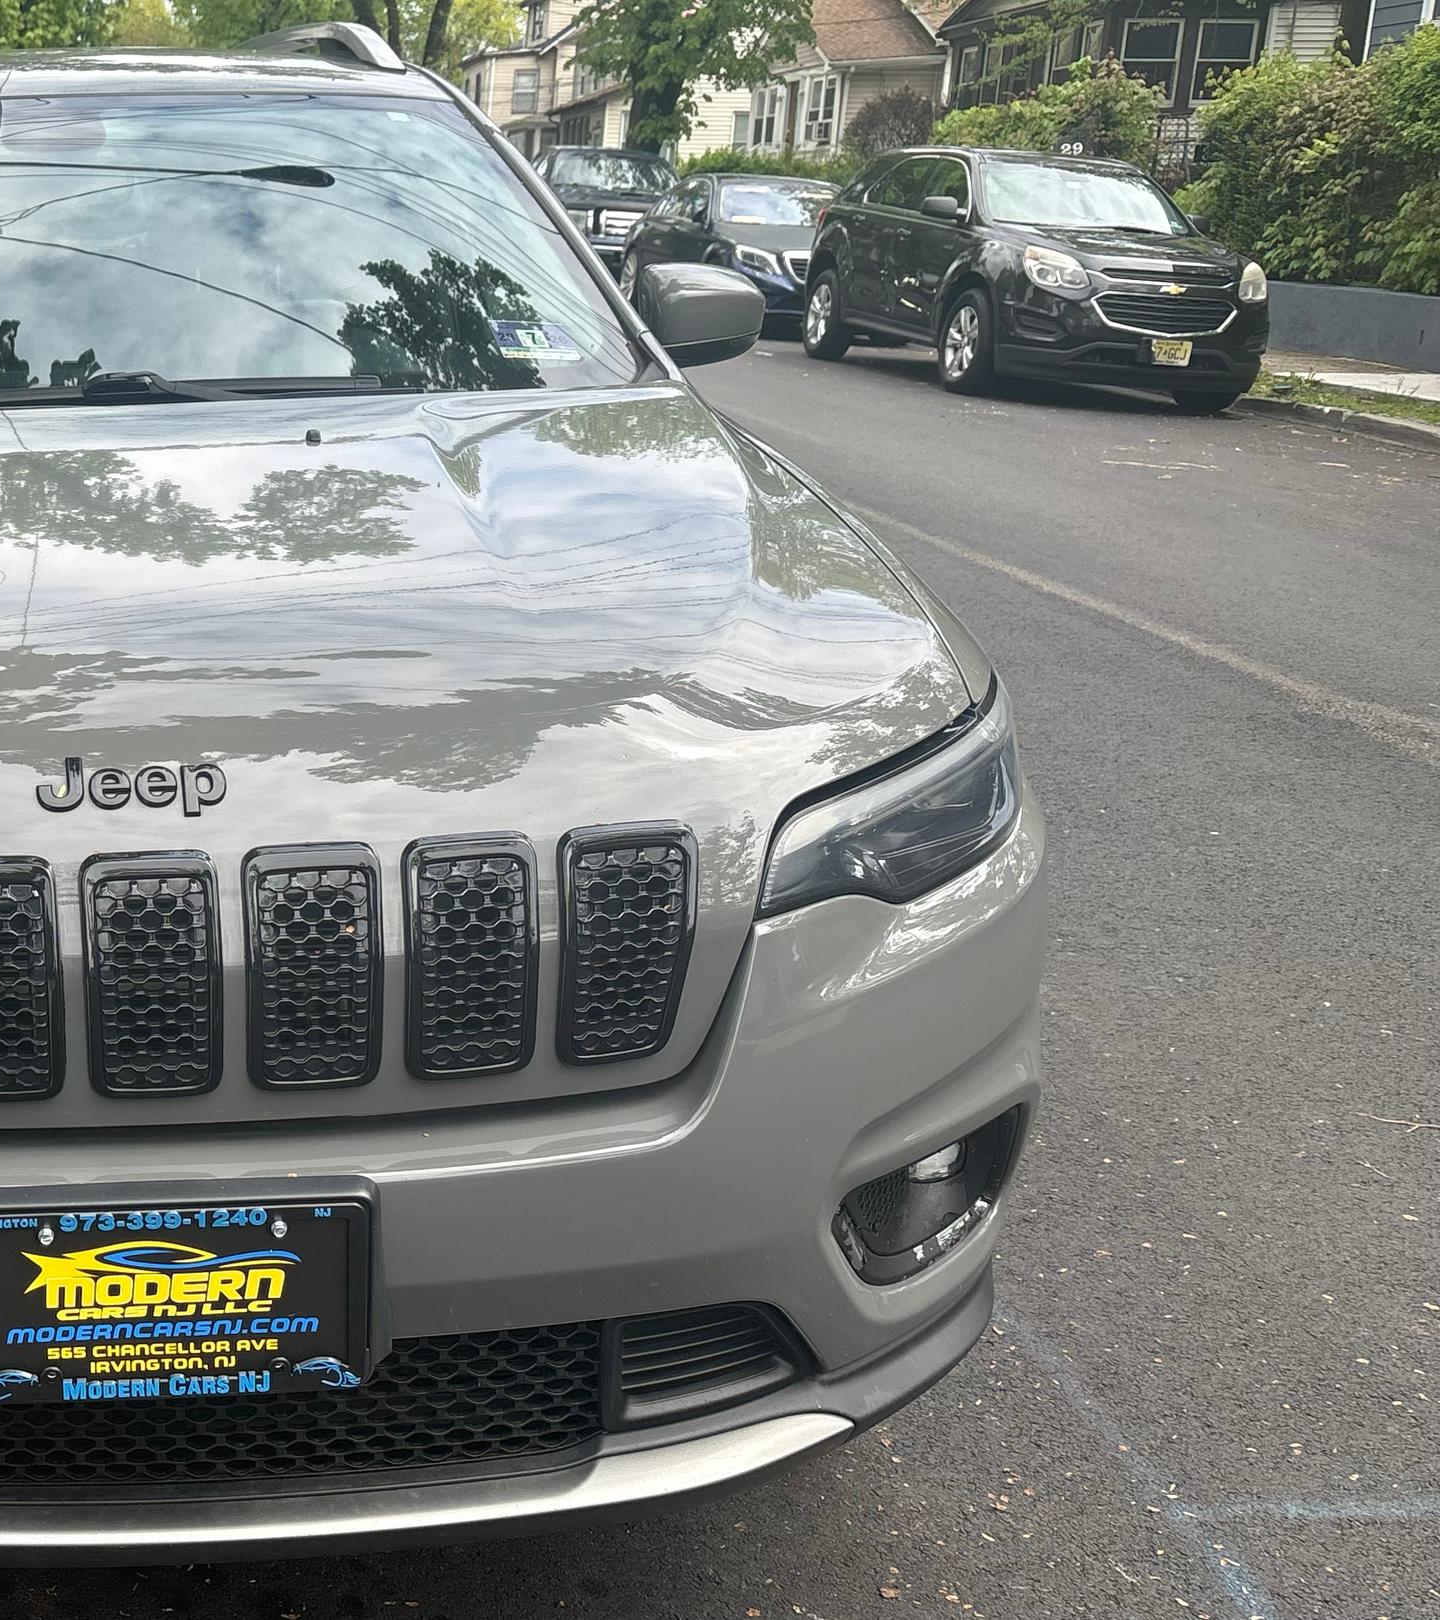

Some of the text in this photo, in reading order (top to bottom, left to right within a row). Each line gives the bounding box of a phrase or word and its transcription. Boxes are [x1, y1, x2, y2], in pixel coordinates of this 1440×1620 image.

[1060, 142, 1083, 156] 29
[35, 756, 227, 818] Jeep
[59, 1206, 268, 1233] 973-399-1240
[313, 1207, 333, 1218] NJ
[55, 1304, 149, 1322] CARS
[201, 1299, 273, 1315] LLC
[46, 1338, 279, 1361] 565 CHANCELLOR AVE
[89, 1355, 237, 1375] IRVINGTON, NJ
[238, 1370, 271, 1393] NJ
